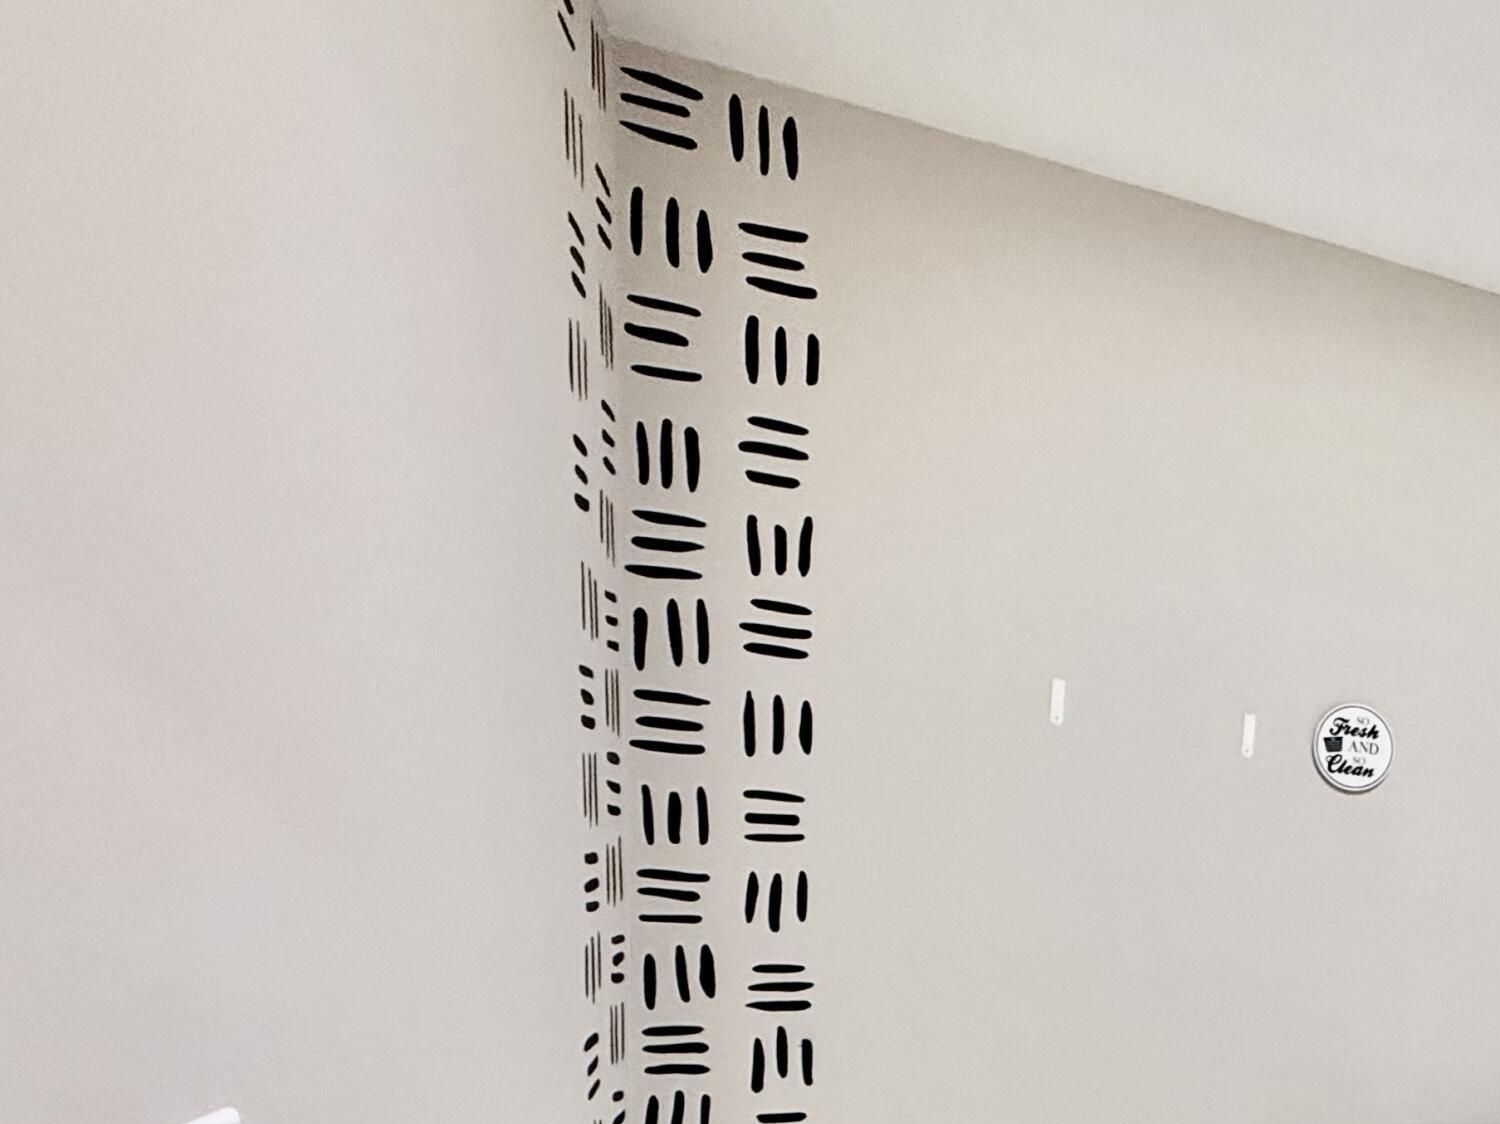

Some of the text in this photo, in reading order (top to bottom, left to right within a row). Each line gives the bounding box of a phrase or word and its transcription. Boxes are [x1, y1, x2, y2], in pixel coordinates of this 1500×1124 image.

[1329, 717, 1379, 740] Fresh
[1349, 740, 1379, 755] AND
[1325, 753, 1374, 778] Clean
